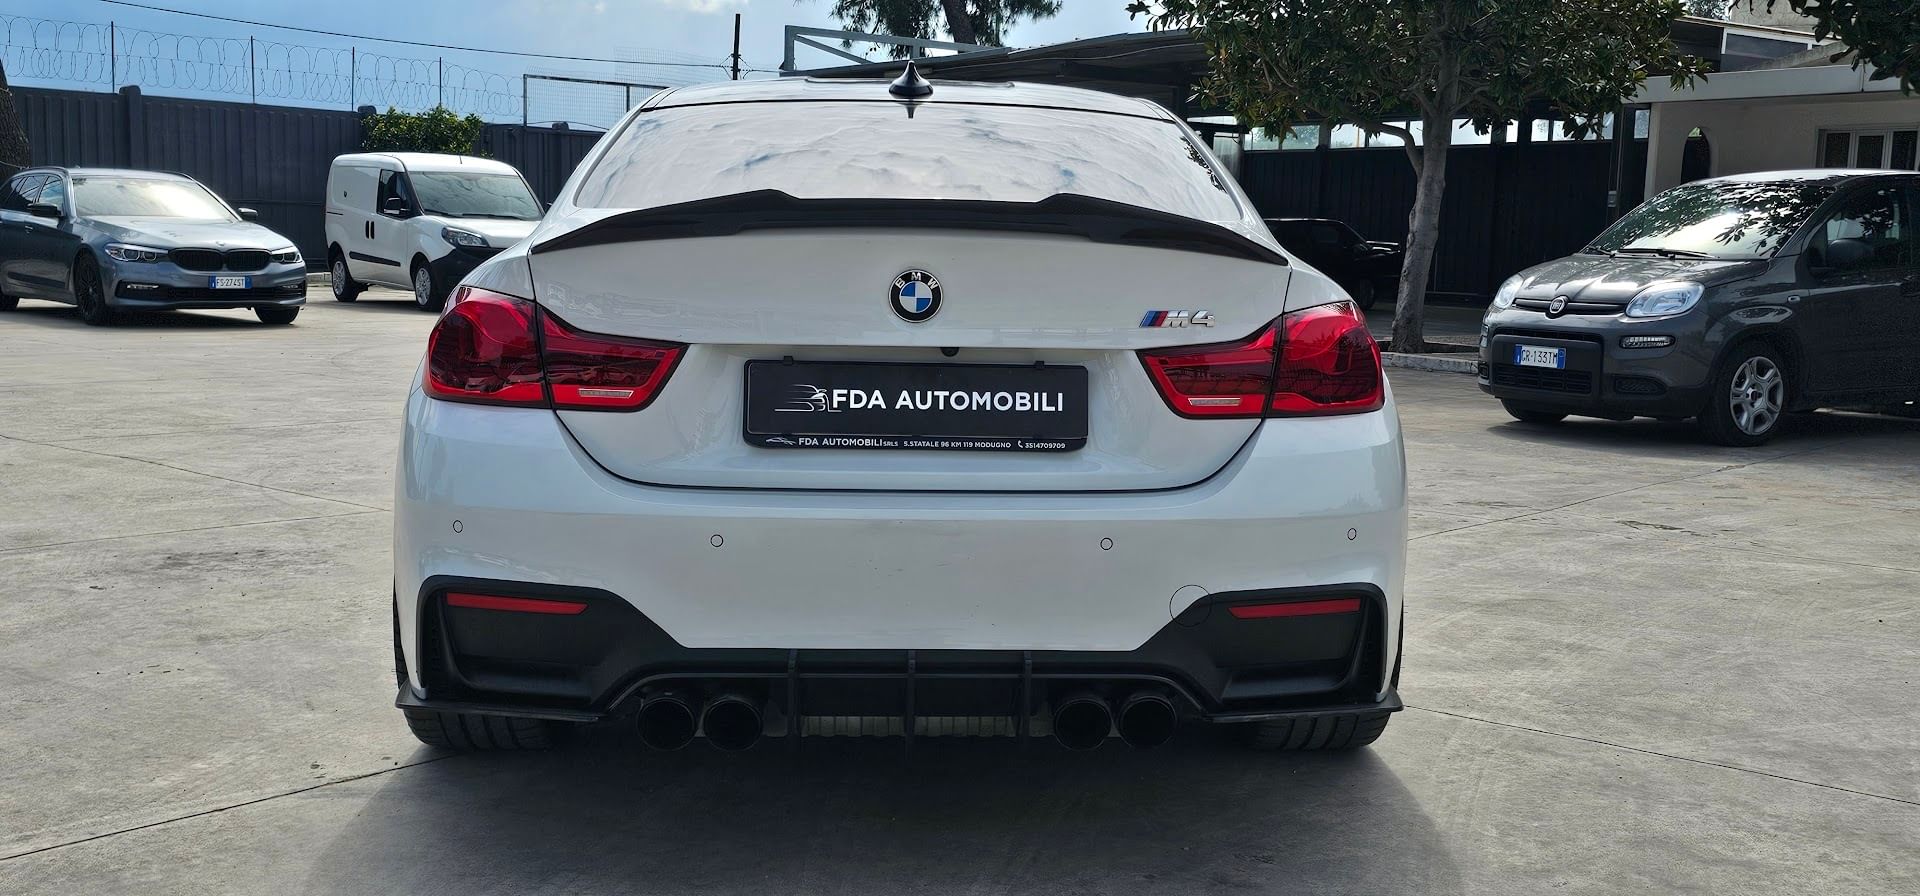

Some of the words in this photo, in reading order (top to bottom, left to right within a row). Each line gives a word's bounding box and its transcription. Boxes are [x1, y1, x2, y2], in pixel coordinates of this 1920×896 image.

[895, 271, 939, 290] BMW
[833, 389, 886, 409] FDA
[895, 390, 1063, 411] AUTOMOBILI
[798, 437, 819, 446] FDA
[822, 438, 882, 446] AUTOMOBILI
